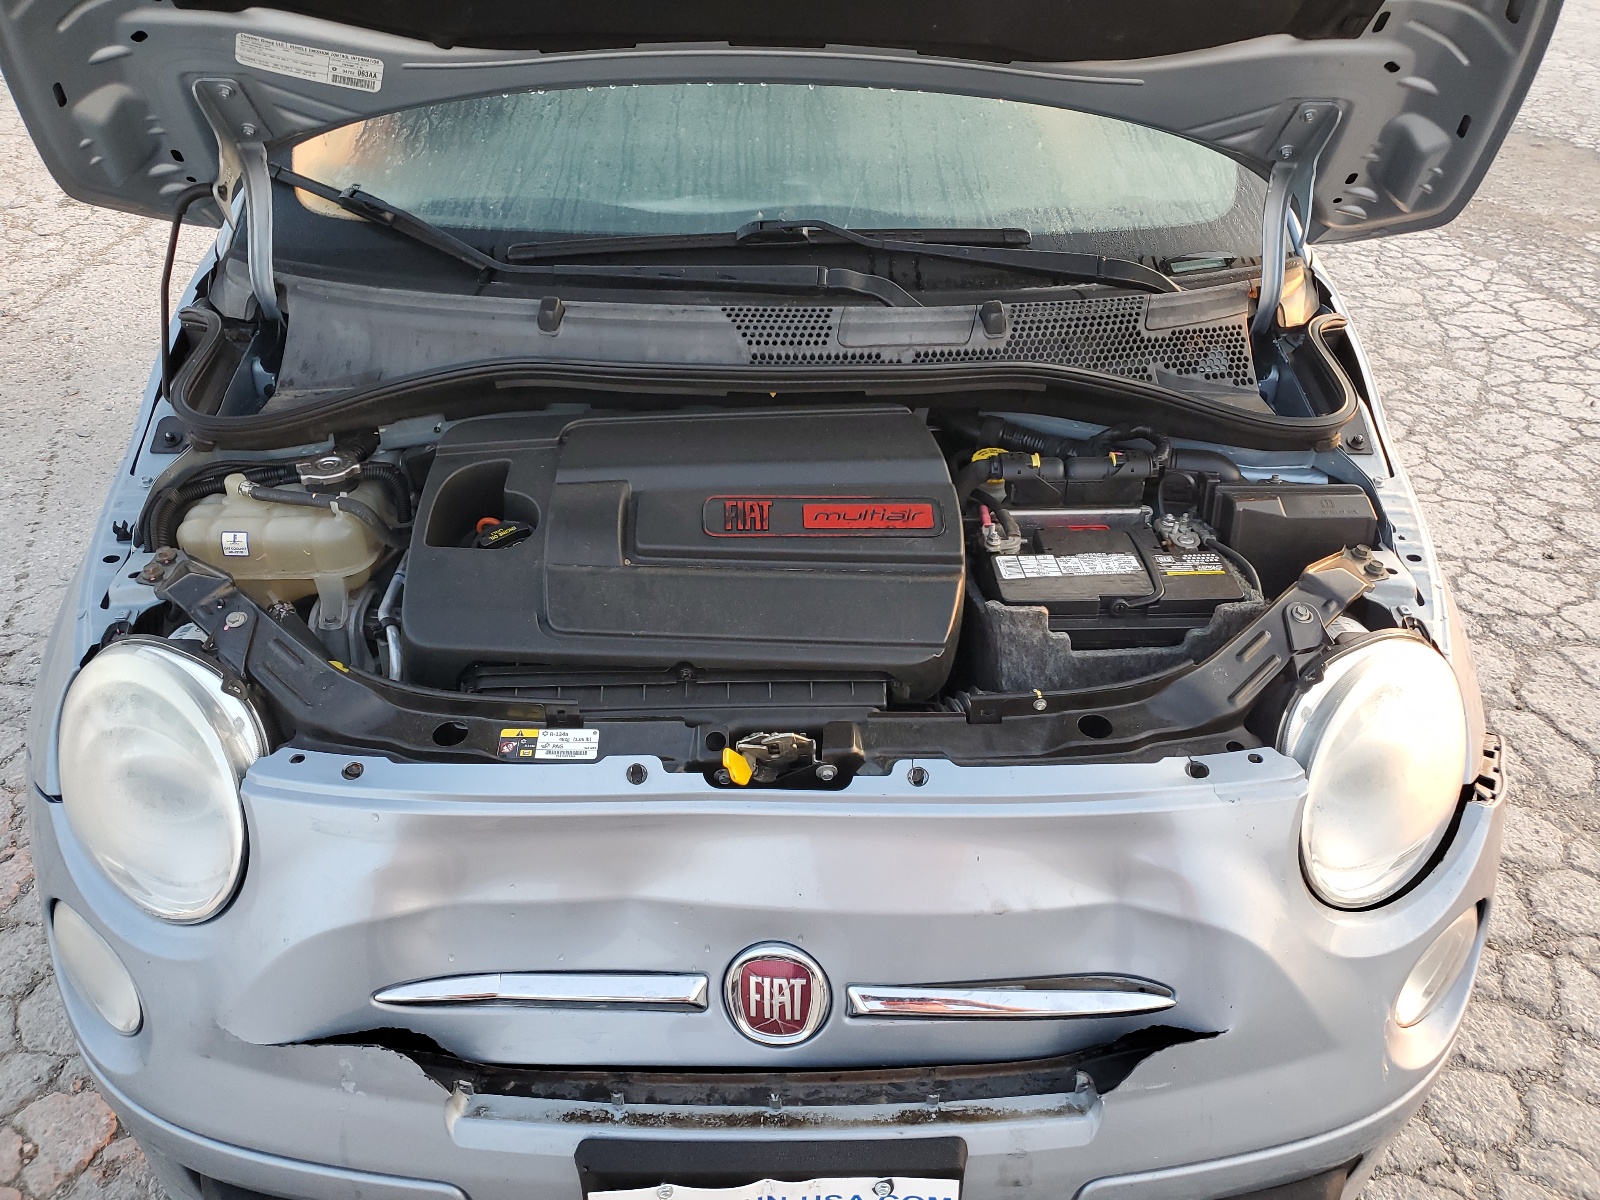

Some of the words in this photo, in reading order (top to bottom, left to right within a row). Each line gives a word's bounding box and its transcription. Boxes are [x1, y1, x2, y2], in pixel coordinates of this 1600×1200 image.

[330, 52, 350, 60] CONTROL
[350, 56, 380, 65] INFORMATION
[724, 500, 773, 531] FIAT
[813, 508, 924, 522] multiair
[749, 975, 806, 1021] FIAT
